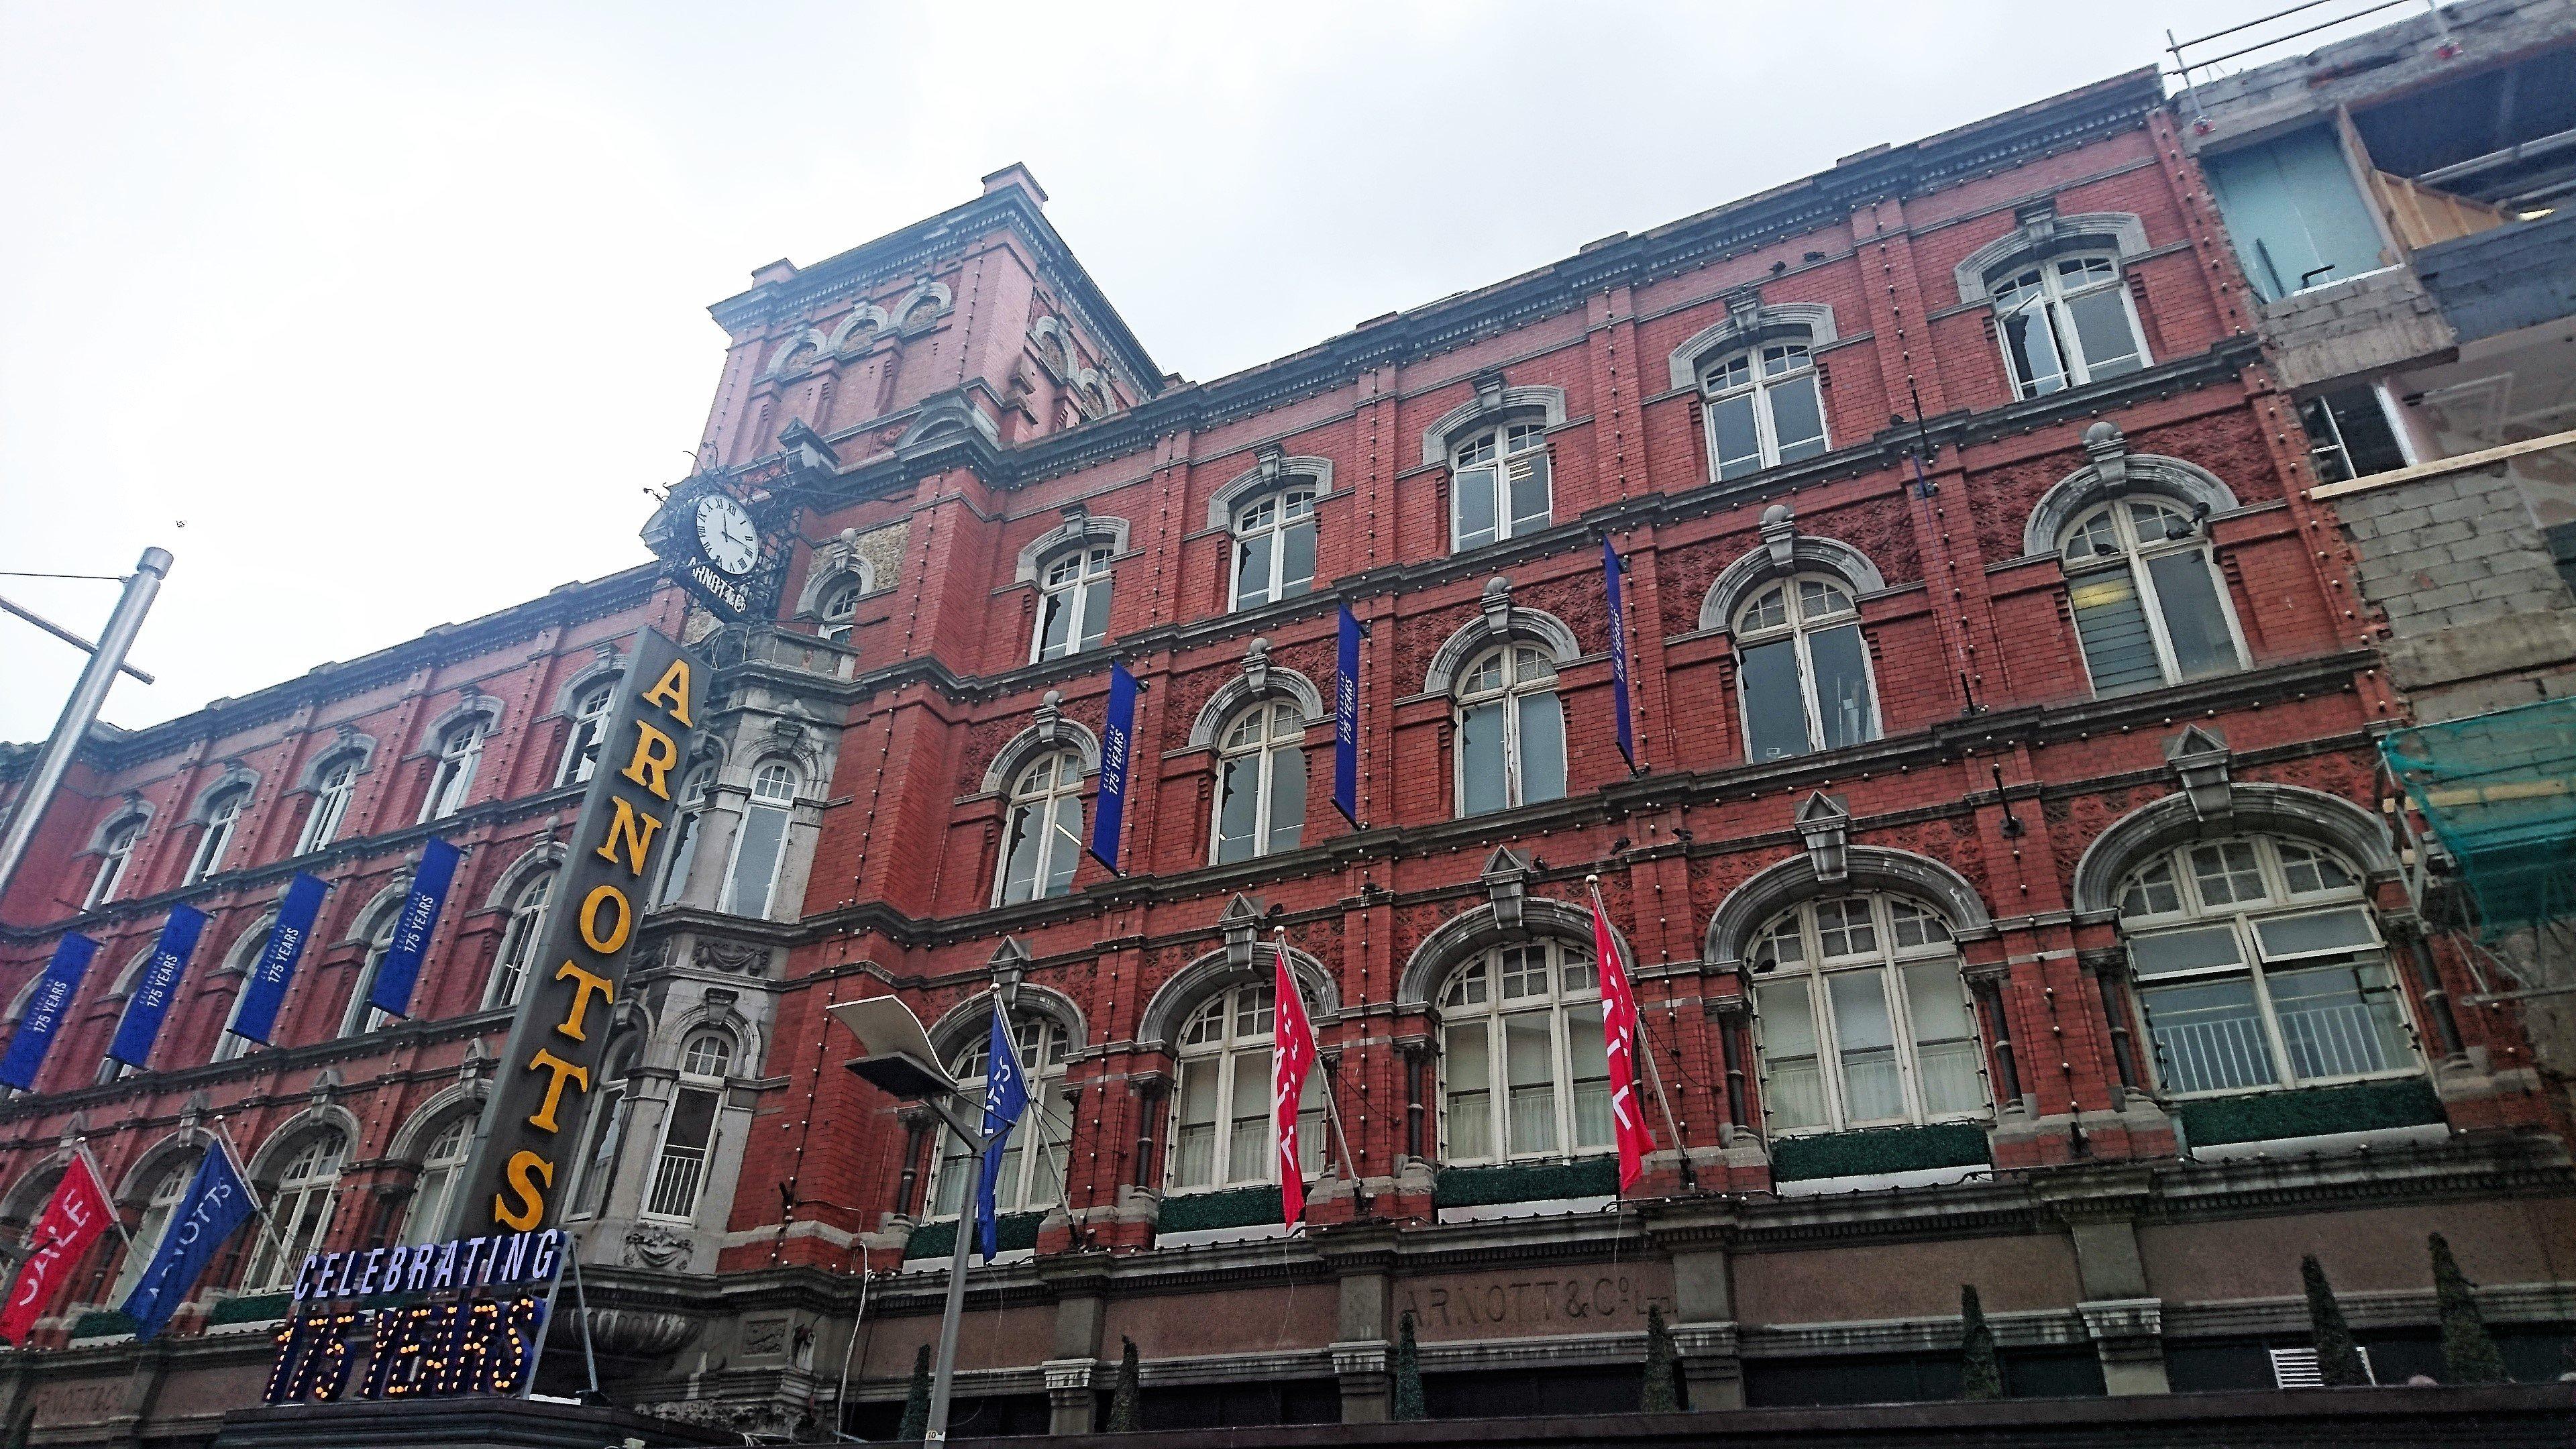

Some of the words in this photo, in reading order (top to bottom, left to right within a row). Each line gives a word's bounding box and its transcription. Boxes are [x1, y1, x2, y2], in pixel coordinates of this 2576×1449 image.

[1344, 676, 1353, 719] YEARS
[1344, 718, 1352, 745] 175
[1111, 729, 1124, 771] YEARS
[1108, 770, 1120, 796] 175
[411, 894, 433, 930] YEARS
[275, 927, 299, 962] YEARS
[404, 932, 420, 953] 175
[494, 658, 694, 1232] ARNOTTS
[154, 954, 178, 987] YEARS
[268, 963, 284, 983] 175
[33, 1014, 50, 1032] 175
[42, 981, 67, 1012] YEARS
[147, 988, 163, 1007] 175
[294, 1228, 558, 1301] CELEBRATING
[263, 1313, 358, 1402] 175
[362, 1296, 539, 1400] YEARS
